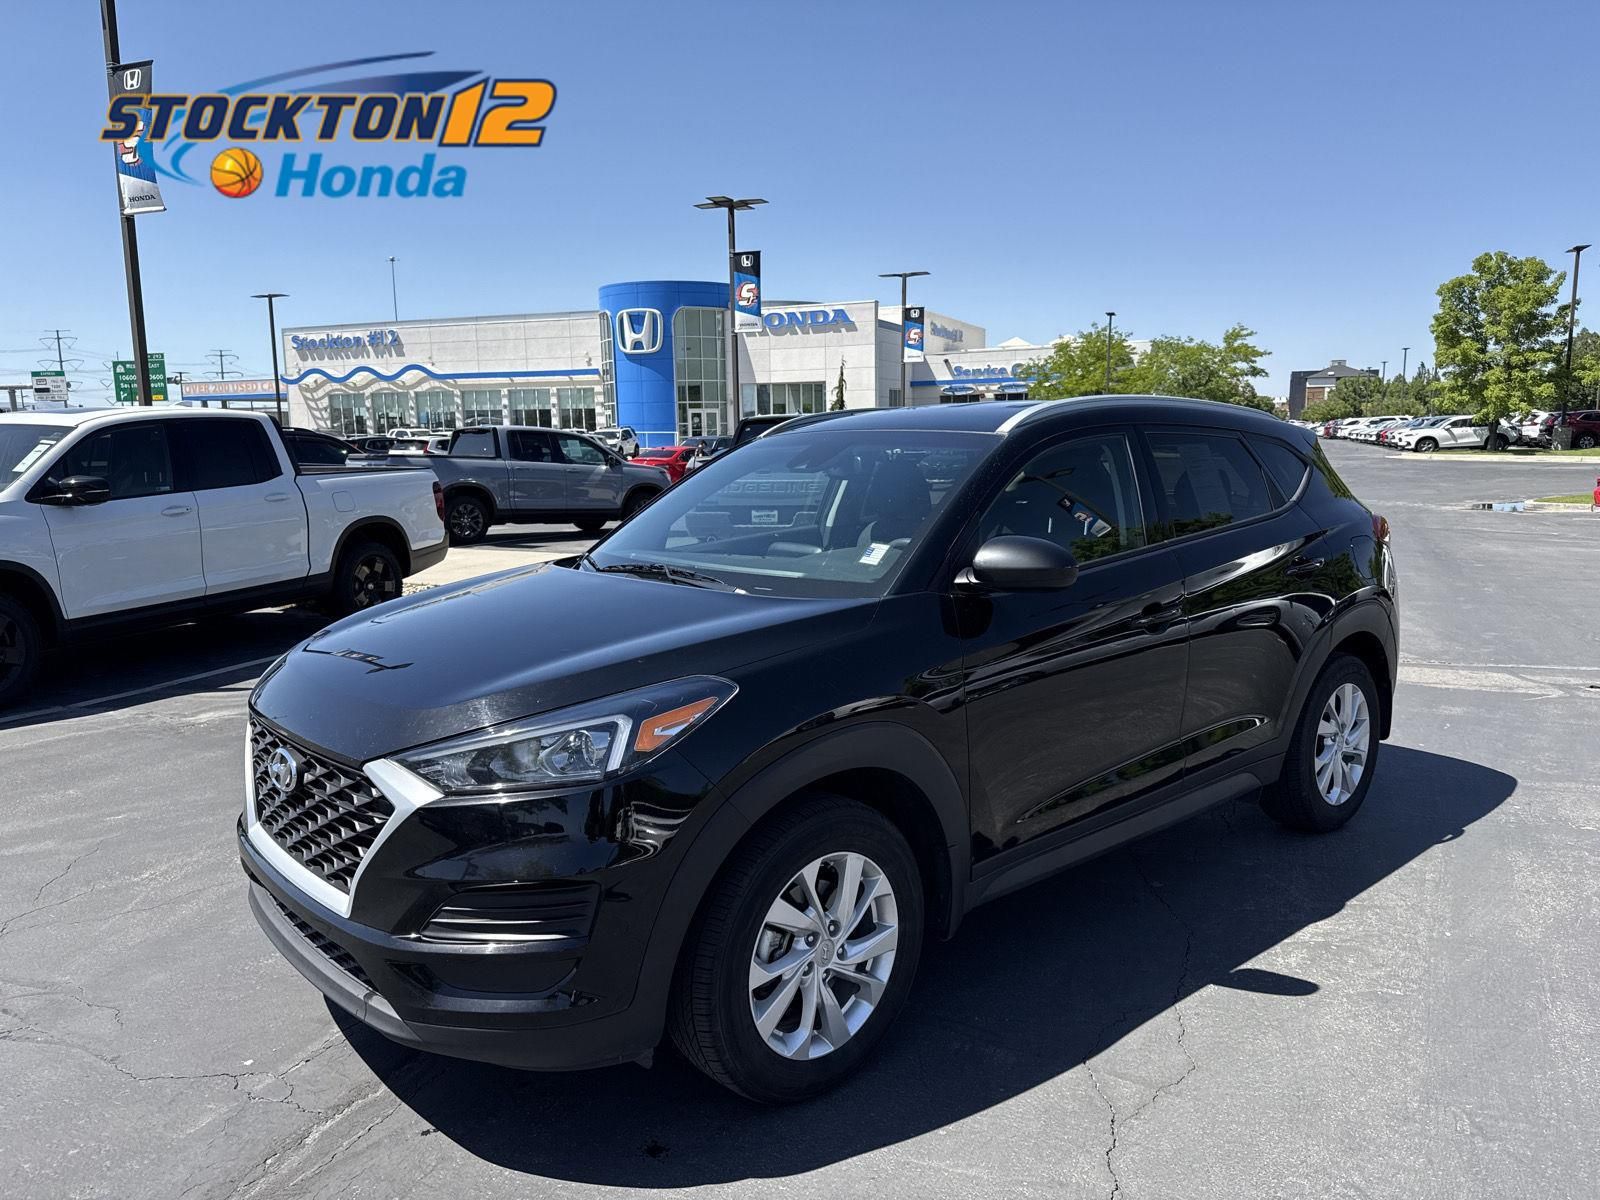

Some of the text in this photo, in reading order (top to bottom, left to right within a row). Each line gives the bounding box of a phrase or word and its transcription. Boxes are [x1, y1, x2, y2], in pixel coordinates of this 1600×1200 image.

[128, 194, 156, 203] HONDA
[763, 308, 854, 329] ONDA
[291, 329, 399, 350] Stockton #12
[953, 364, 1008, 377] Service
[184, 380, 288, 394] OVER 200 USED CAS
